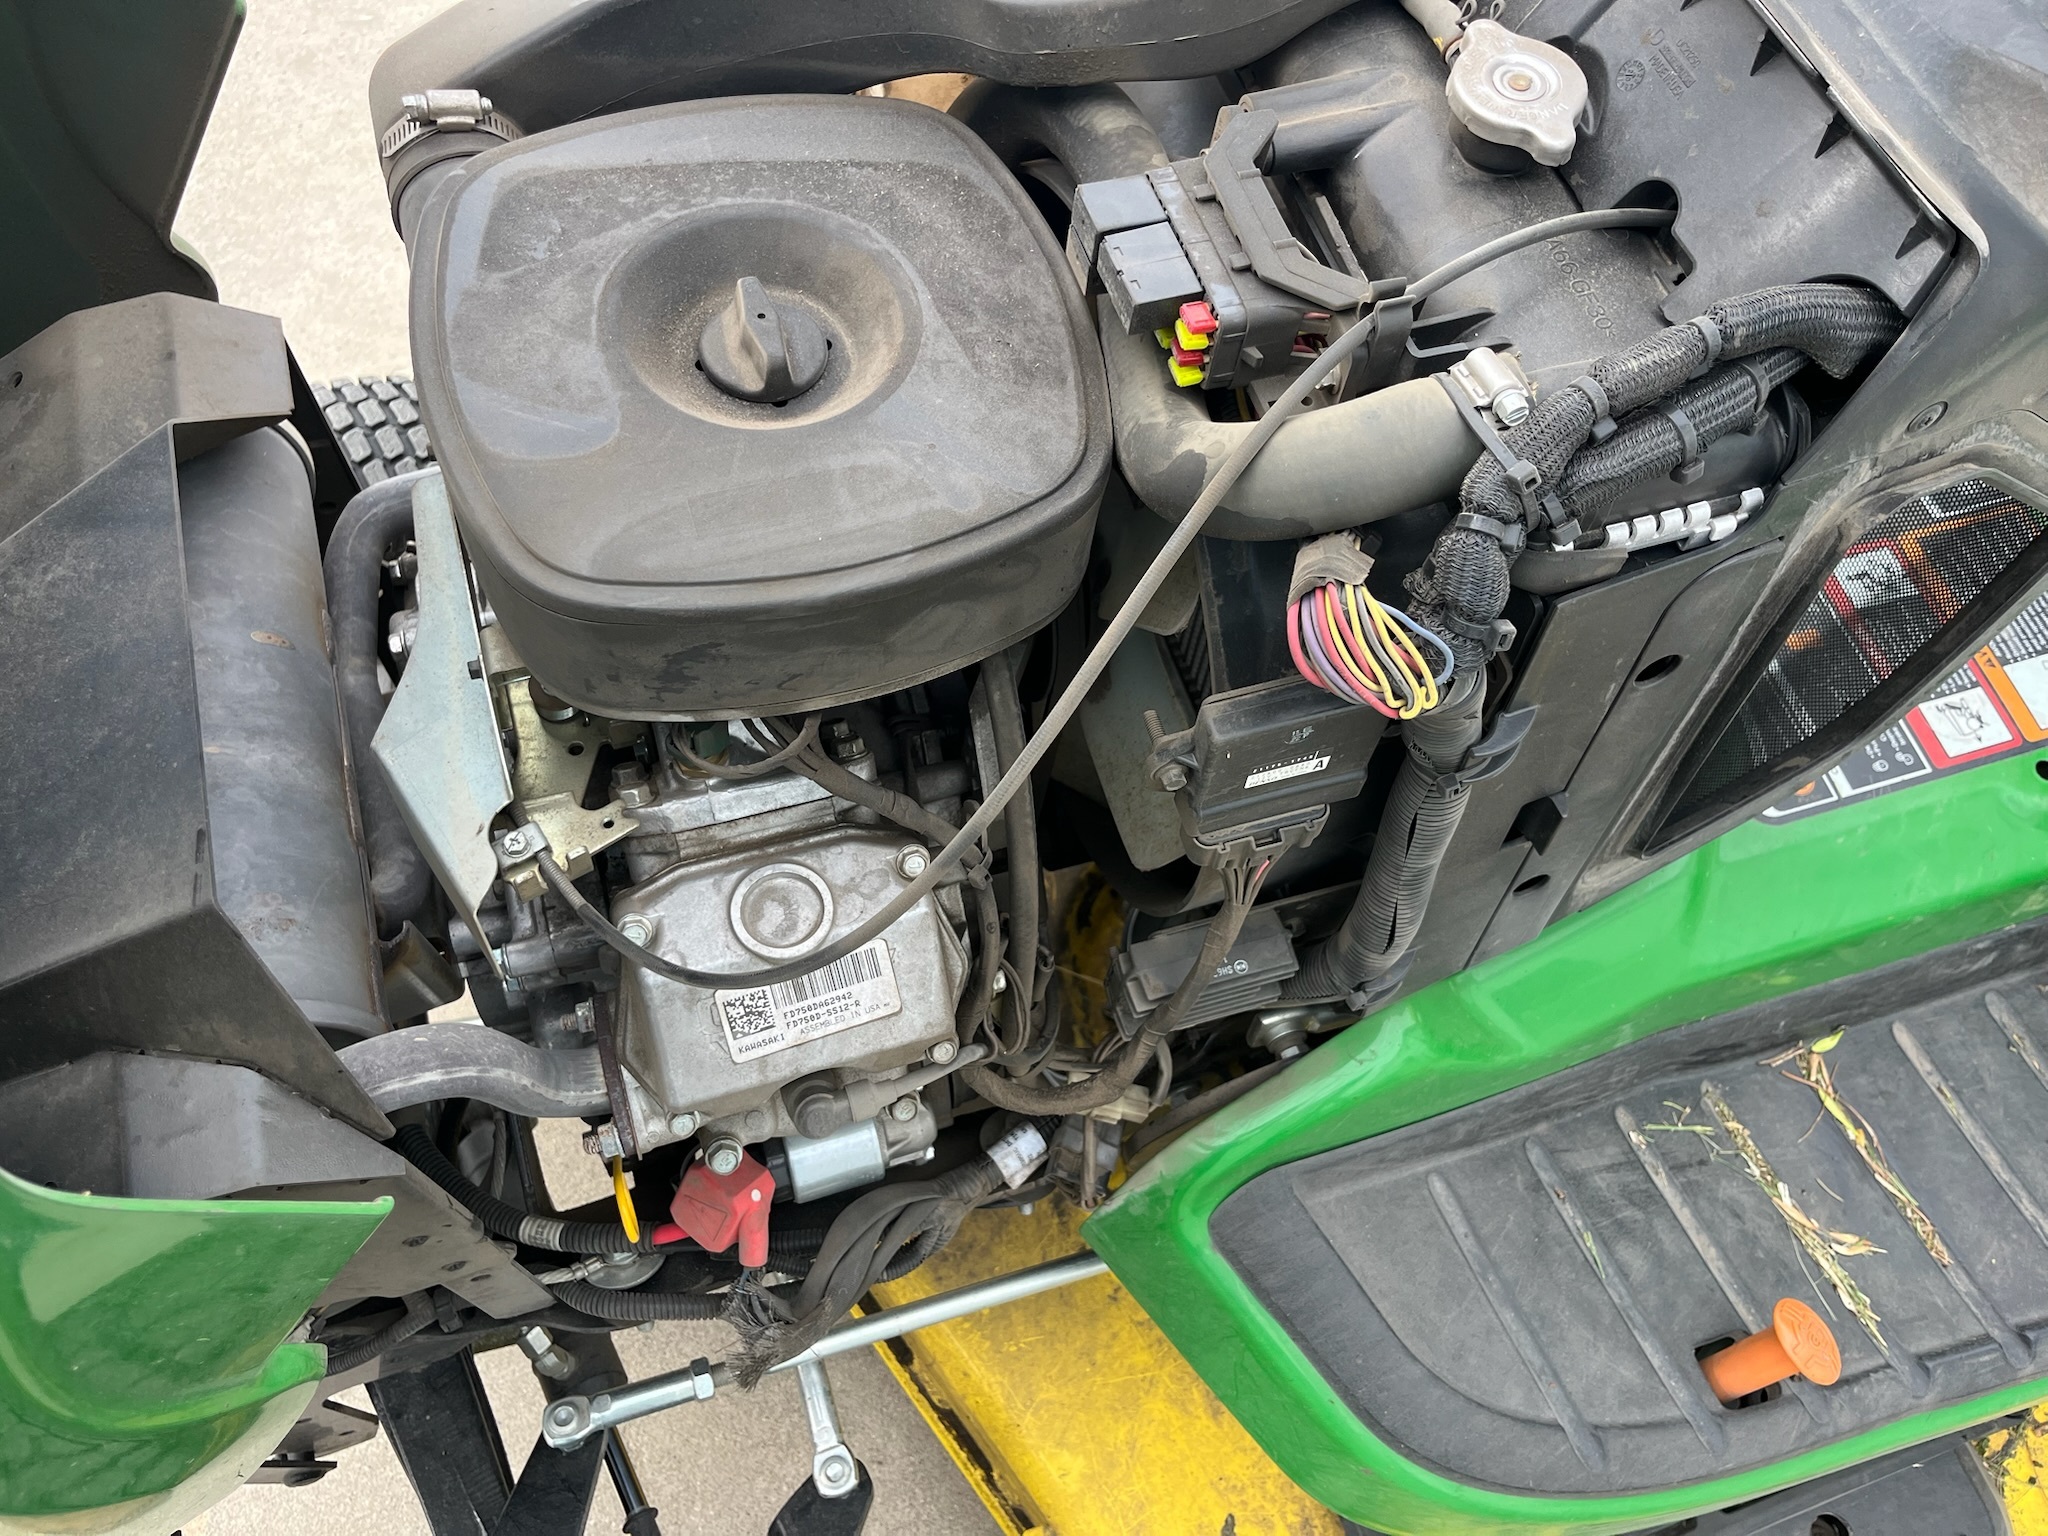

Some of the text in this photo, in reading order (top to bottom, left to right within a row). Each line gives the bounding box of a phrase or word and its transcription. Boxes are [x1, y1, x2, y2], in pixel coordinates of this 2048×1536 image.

[783, 991, 853, 1020] FD750DA62942
[786, 999, 861, 1029] FD750D-SS12-R
[799, 1015, 846, 1035] ASSEMBLED
[851, 1010, 862, 1019] IN
[865, 1004, 881, 1014] USA
[738, 1033, 785, 1054] KAWASAKI
